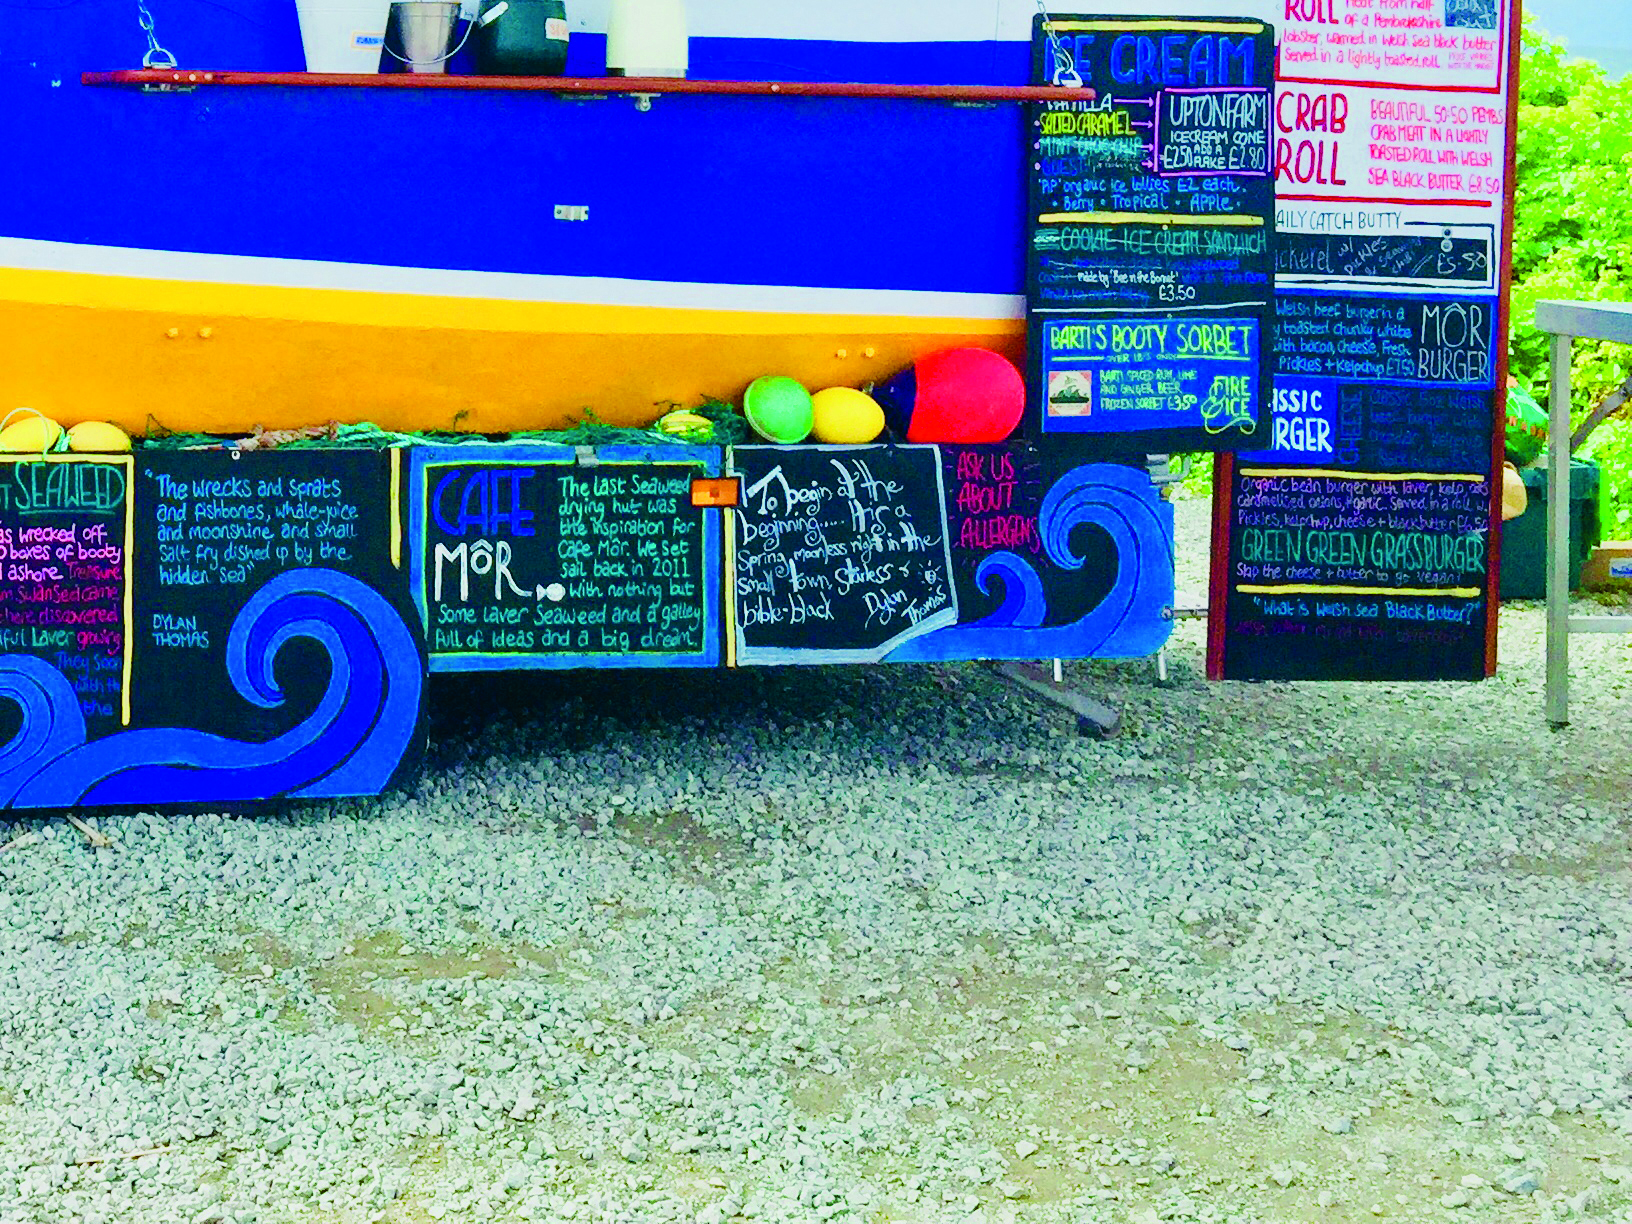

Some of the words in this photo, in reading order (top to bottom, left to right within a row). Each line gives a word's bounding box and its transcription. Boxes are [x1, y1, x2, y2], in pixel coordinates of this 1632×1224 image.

[1110, 35, 1255, 86] CREAM
[1040, 112, 1075, 134] SALTED
[1077, 111, 1136, 136] CARAMEL
[1276, 91, 1348, 133] CRAB
[1233, 130, 1265, 144] CONE
[1229, 146, 1265, 169] £2.80
[1275, 138, 1346, 185] ROLL
[1177, 179, 1199, 192] £2
[1392, 172, 1425, 187] BLACK
[1428, 174, 1464, 190] BUTTER
[1112, 195, 1168, 209] Tropical
[1310, 211, 1353, 228] CATCH
[1358, 211, 1402, 228] BUTTY
[1159, 285, 1196, 301] £3.50
[1112, 325, 1168, 353] BOOTY
[1177, 324, 1252, 355] SORBET
[1418, 348, 1488, 382] BURGER
[1225, 398, 1251, 416] ICE
[957, 451, 987, 481] ASK
[991, 452, 1015, 480] US
[258, 480, 283, 496] and
[956, 482, 1018, 514] ABOUT
[432, 468, 535, 536] CAFE
[961, 514, 1040, 554] ALLERGENS
[1242, 528, 1302, 562] GREEN
[1306, 530, 1367, 566] GREEN
[594, 559, 628, 576] back
[652, 558, 690, 576] 2011
[153, 614, 196, 631] DYLAN
[612, 606, 641, 624] and
[662, 603, 701, 630] galley
[152, 632, 209, 648] THOMAS
